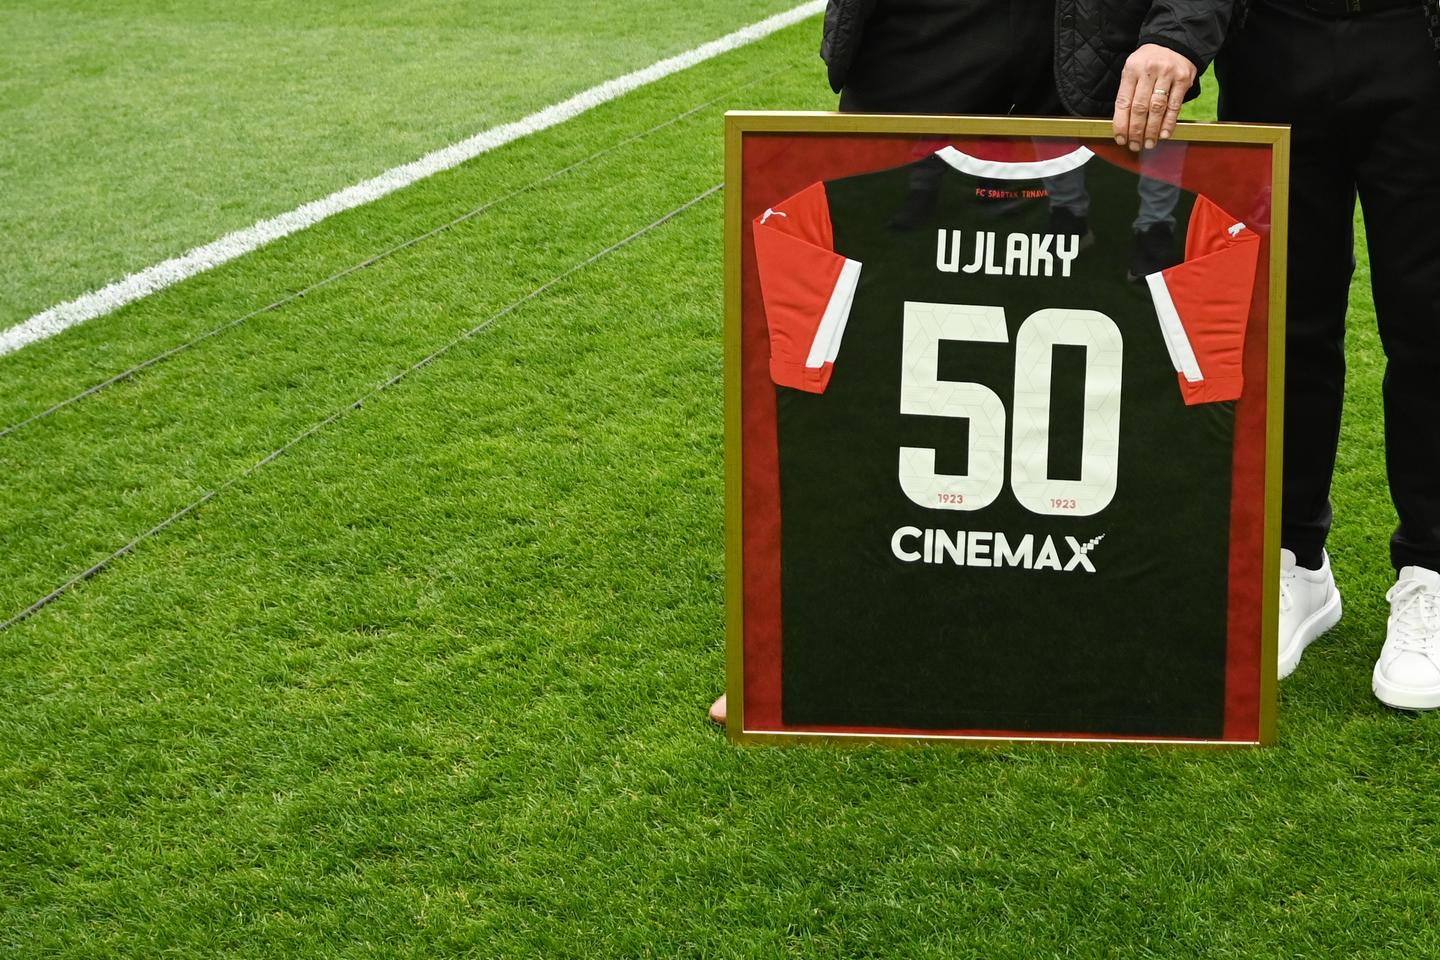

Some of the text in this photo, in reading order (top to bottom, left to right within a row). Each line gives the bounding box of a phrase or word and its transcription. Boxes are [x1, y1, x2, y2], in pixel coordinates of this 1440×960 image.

[975, 188, 986, 197] FC
[988, 189, 1019, 198] SPARTAK
[936, 228, 1080, 278] UJLAKY
[898, 300, 1123, 517] 50
[937, 493, 964, 505] 1923
[1050, 497, 1077, 510] 1923
[891, 526, 1106, 574] CINEMAX
